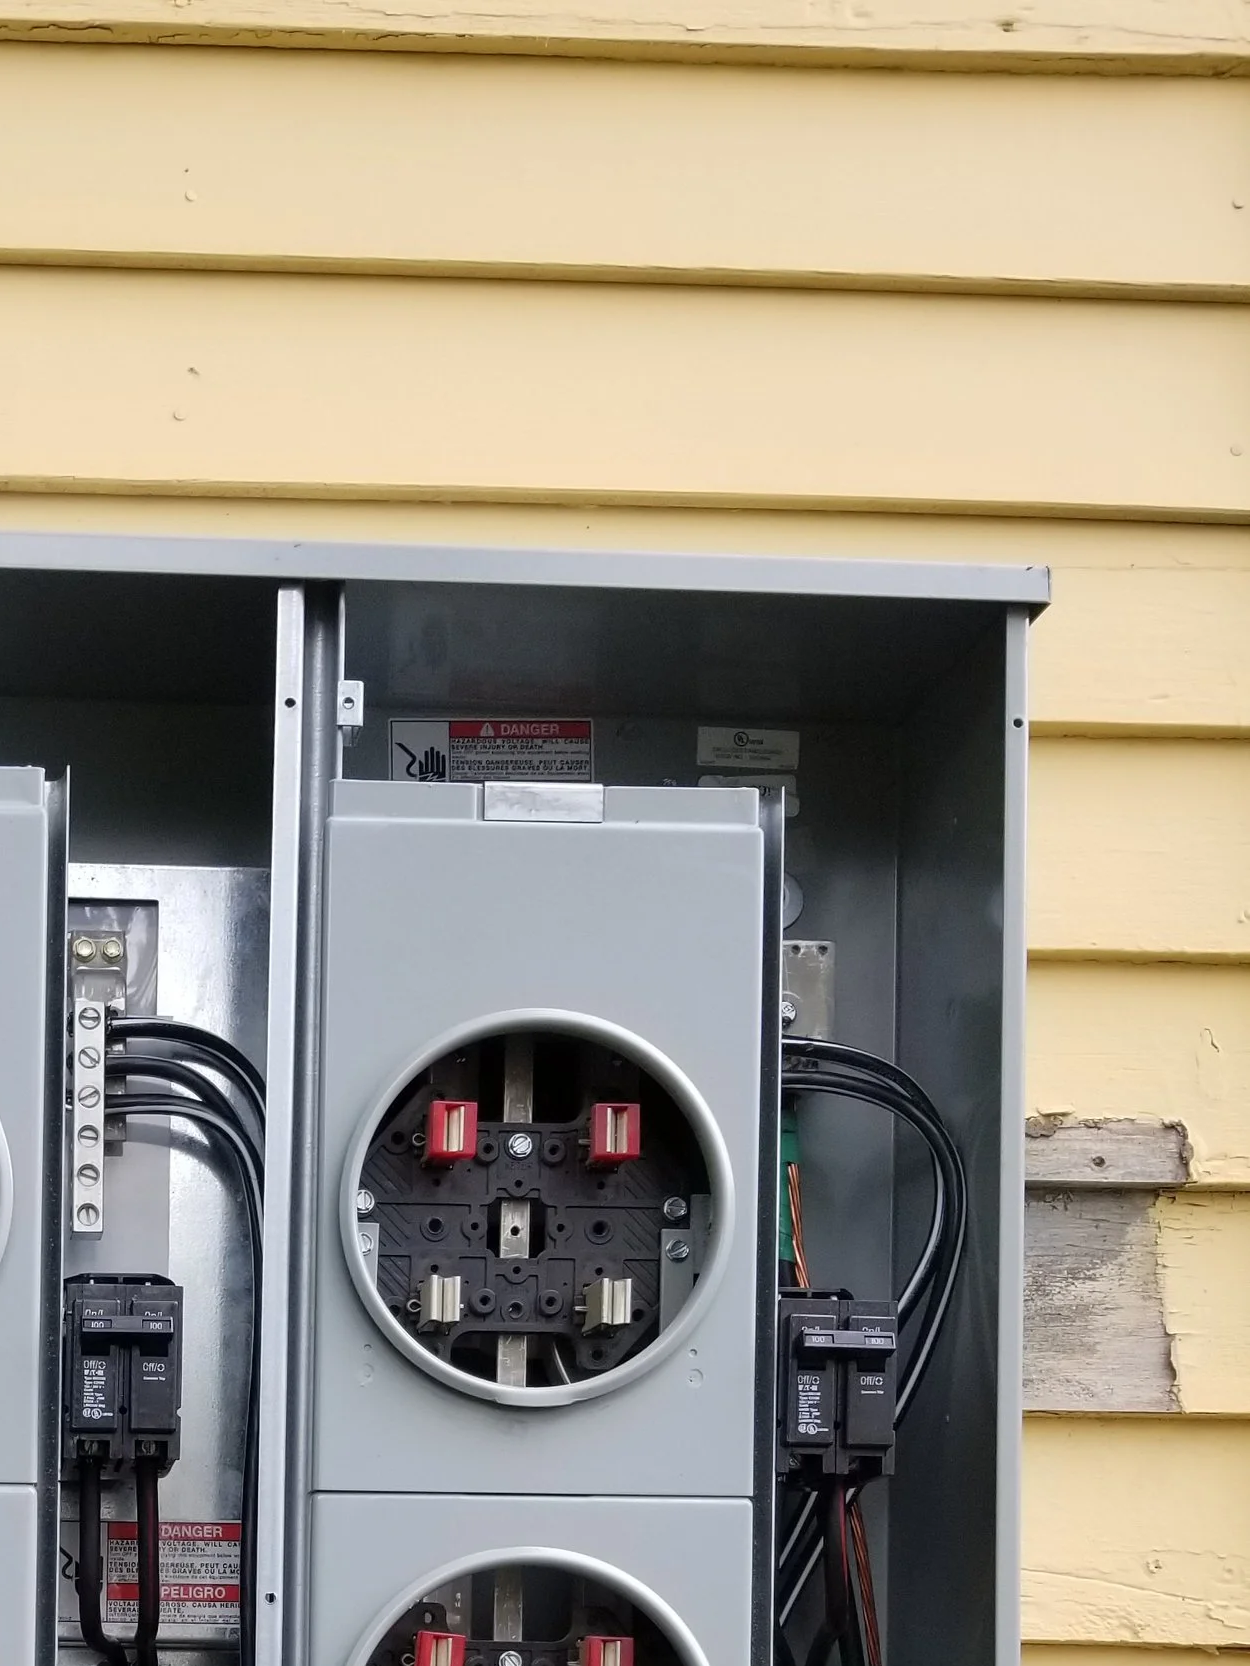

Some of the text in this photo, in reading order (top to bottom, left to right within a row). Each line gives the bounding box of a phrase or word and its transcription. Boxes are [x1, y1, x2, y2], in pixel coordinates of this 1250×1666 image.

[500, 724, 560, 736] DANGER
[150, 1322, 162, 1330] 100
[161, 1525, 223, 1538] DANGER
[161, 1586, 226, 1599] PELIGRO
